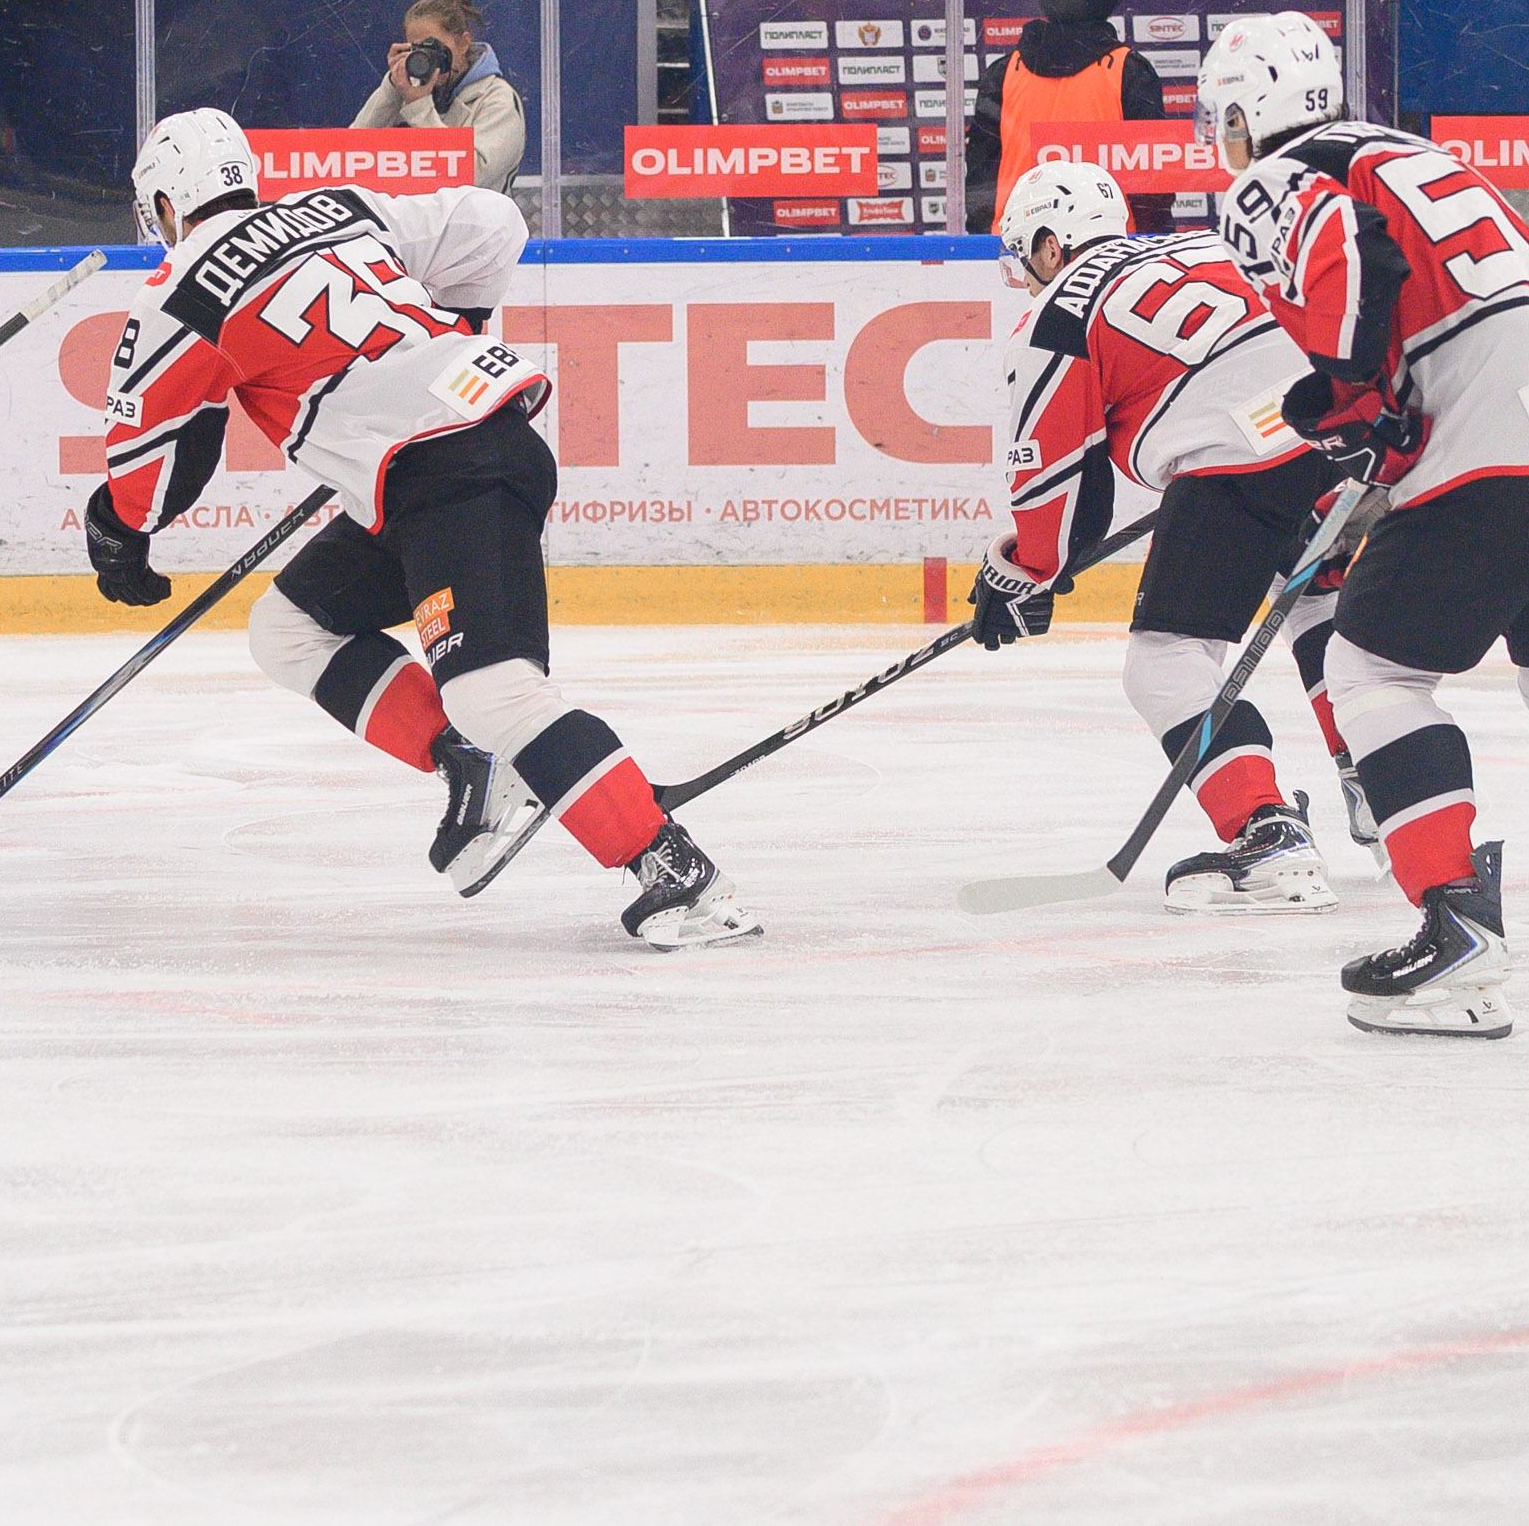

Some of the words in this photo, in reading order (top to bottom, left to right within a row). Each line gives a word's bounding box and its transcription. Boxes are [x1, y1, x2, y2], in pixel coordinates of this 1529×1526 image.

[764, 29, 824, 40] ПОЛИПЛАСТ
[986, 27, 1024, 37] OLIMP
[1149, 22, 1185, 33] SINTEC
[766, 66, 827, 77] OLIMPBET
[842, 65, 901, 75] ПОЛИПЛАСТ
[843, 99, 905, 111] OLIMPBET
[919, 99, 976, 108] ПОЛИСТ
[1163, 93, 1197, 104] MPBET
[1305, 87, 1328, 112] 59
[631, 146, 872, 176] OLIMPBET
[1036, 143, 1228, 171] OLIMPB
[221, 165, 244, 186] 38
[1096, 182, 1115, 200] 67
[776, 207, 838, 218] OLIMPBET
[1030, 201, 1053, 215] ЕВРАЗ
[1171, 199, 1203, 209] ПЛАСТ
[1224, 179, 1272, 261] 59
[1271, 207, 1296, 258] РАЗ
[194, 194, 354, 307] ДЕМИДОВ
[113, 317, 141, 369] 8
[472, 342, 520, 379] ЕВ
[107, 394, 137, 419] РАЗ
[1007, 446, 1035, 467] РАЗ
[61, 503, 255, 531] ААСЛА
[547, 499, 693, 525] ТИФРИЗЫ
[719, 497, 993, 523] АВТОКОСМЕТИКА
[985, 564, 1038, 596] RIOR
[416, 592, 451, 630] EVRAZ
[420, 617, 448, 646] STEEL
[425, 631, 465, 668] UER
[1392, 954, 1434, 979] BAUER
